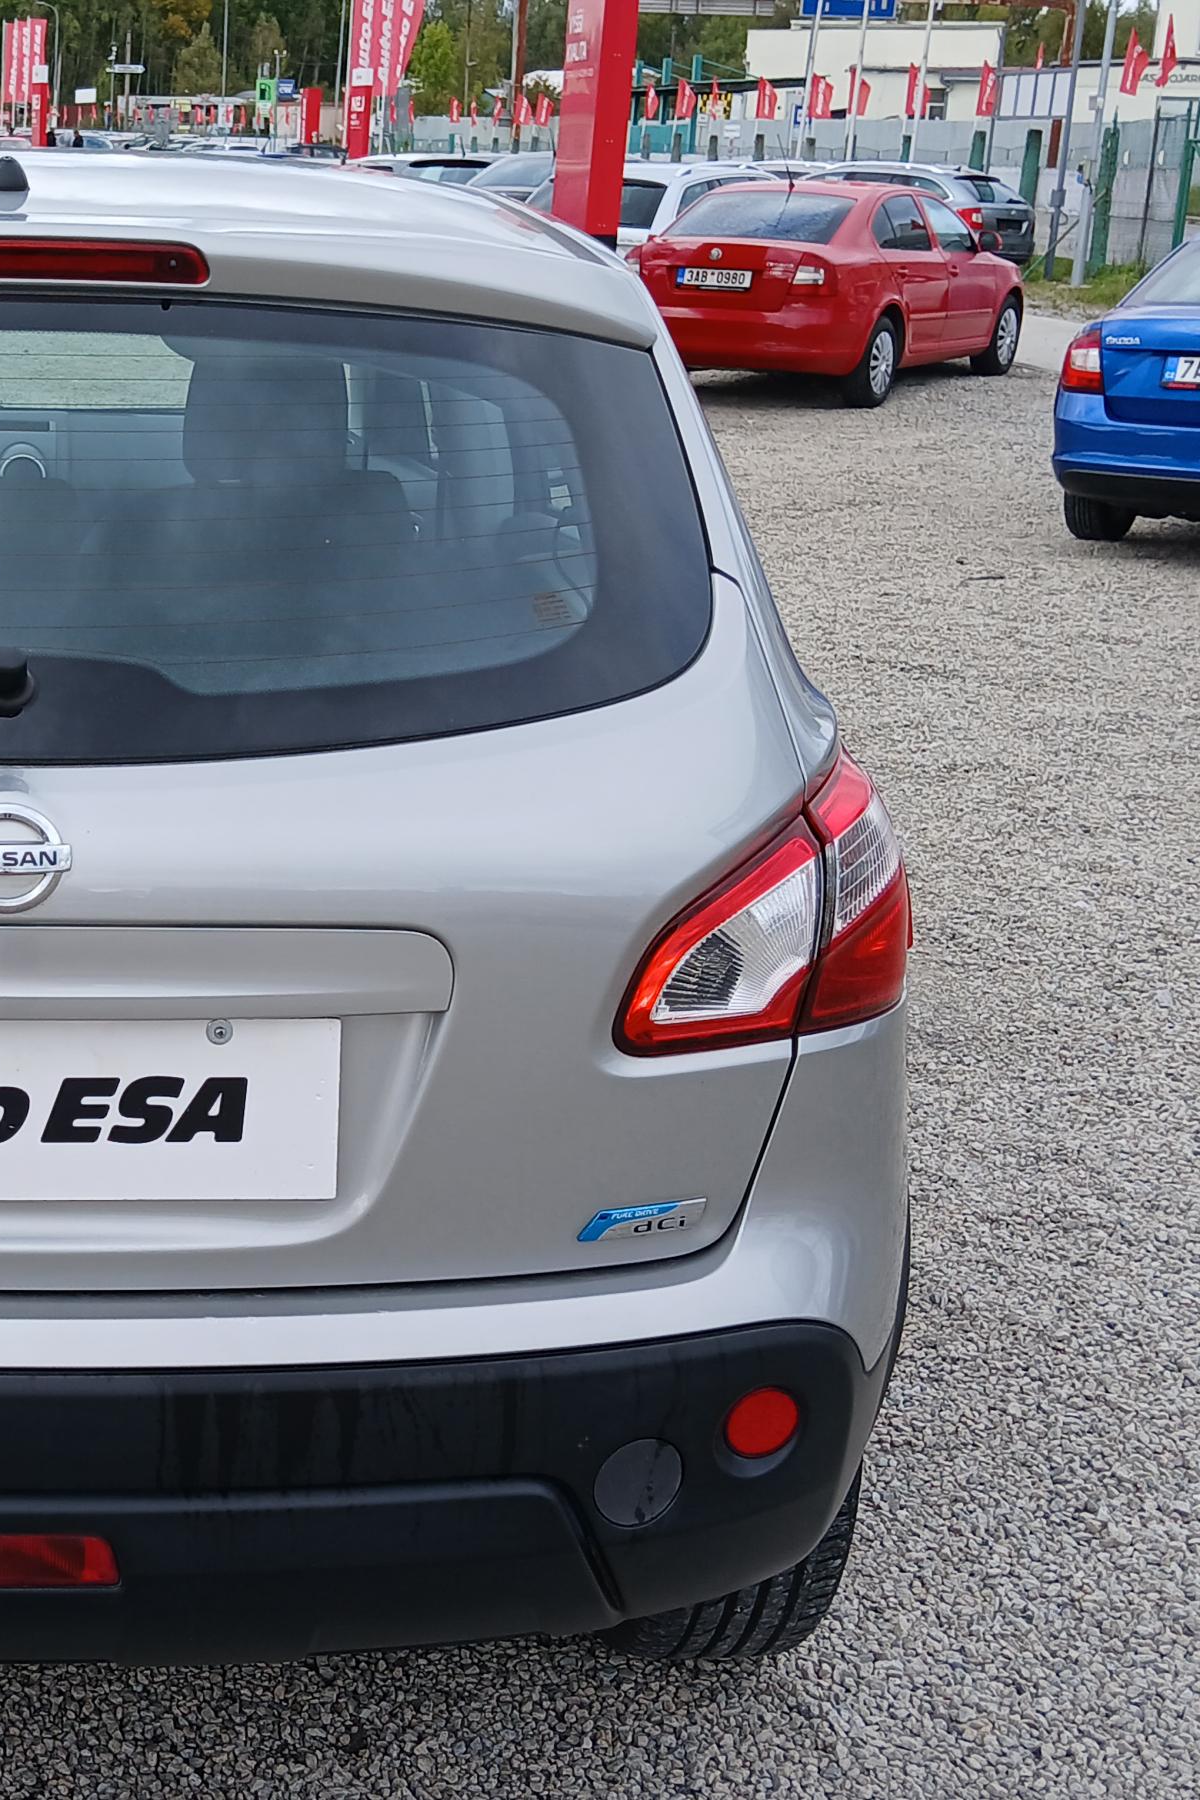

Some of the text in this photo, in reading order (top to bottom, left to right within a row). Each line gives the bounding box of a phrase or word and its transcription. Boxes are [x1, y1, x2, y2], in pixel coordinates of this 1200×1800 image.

[687, 270, 746, 285] 3AB 0980
[40, 1075, 248, 1144] ESA
[611, 1208, 660, 1220] PURE DRIVE
[633, 1215, 686, 1233] dCi
